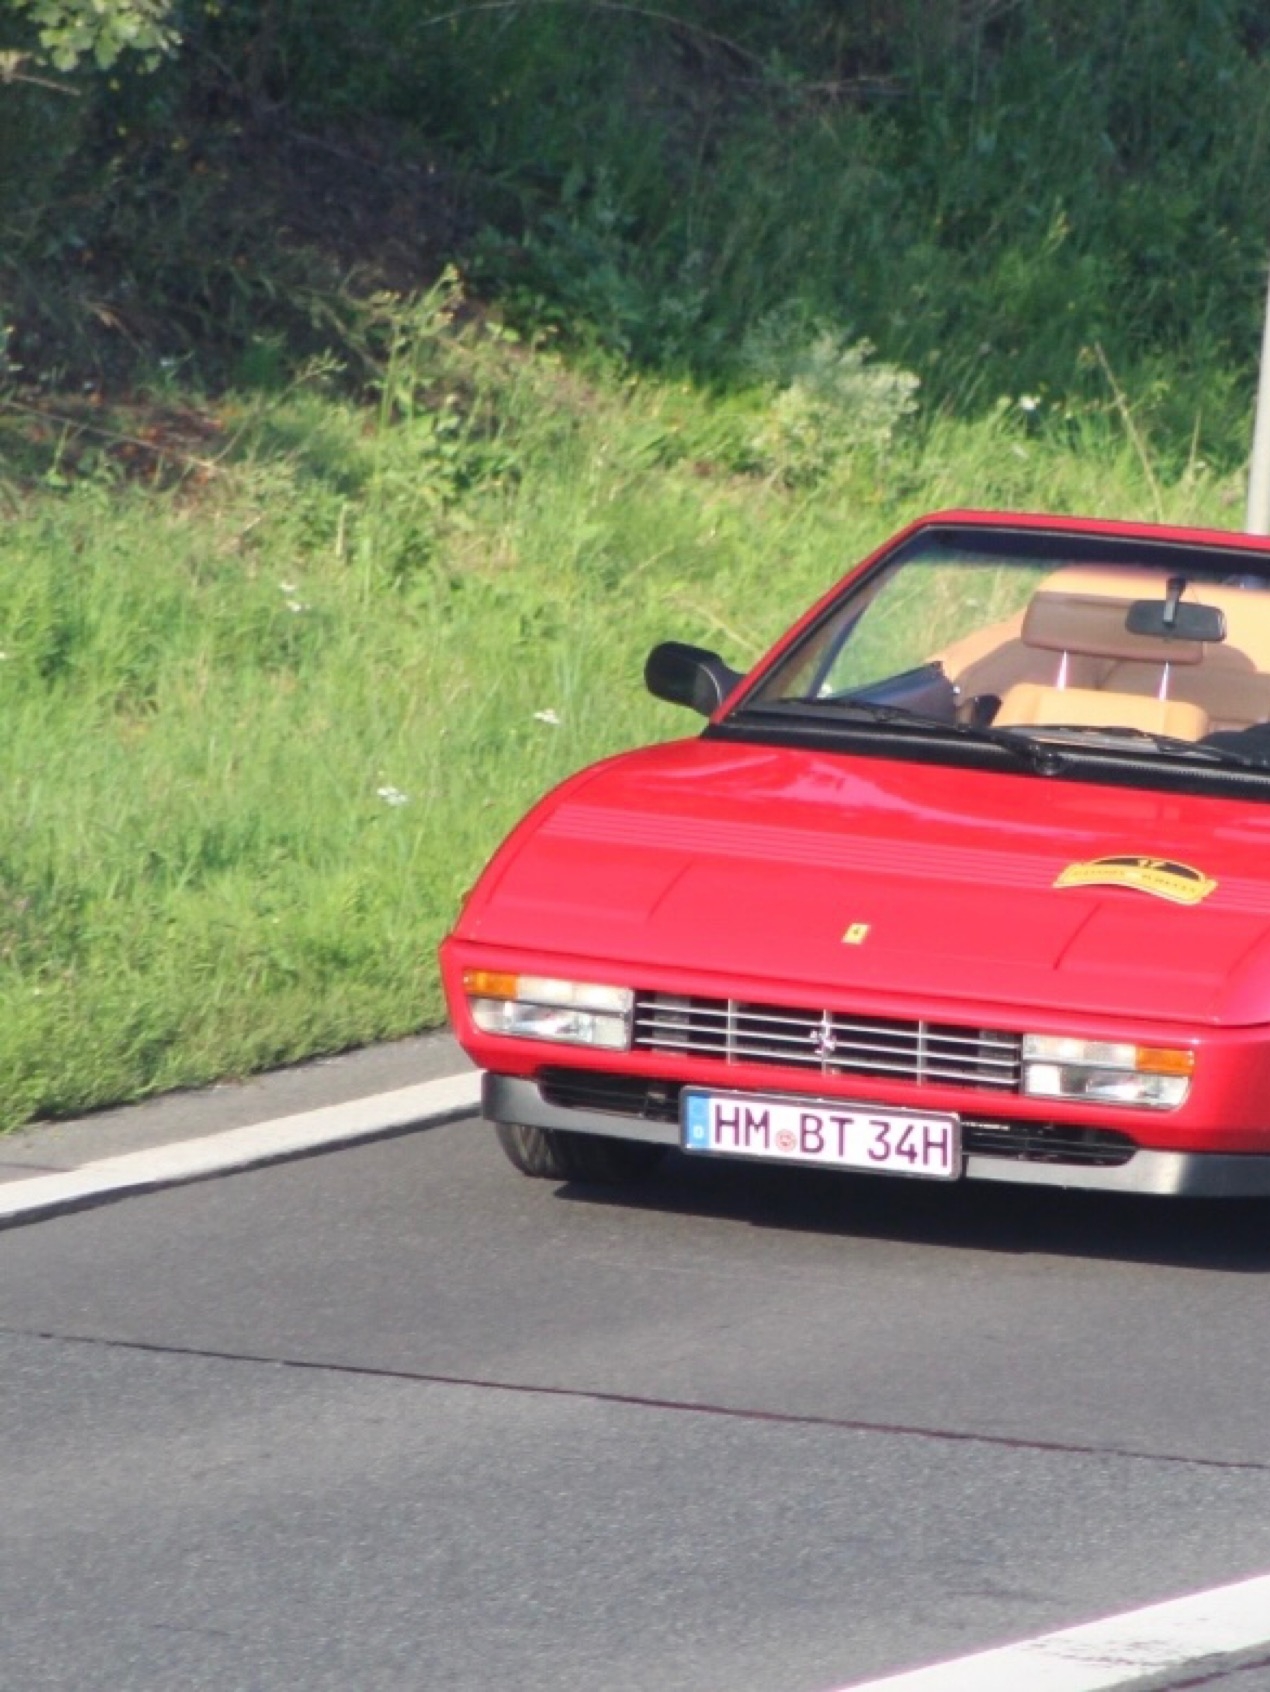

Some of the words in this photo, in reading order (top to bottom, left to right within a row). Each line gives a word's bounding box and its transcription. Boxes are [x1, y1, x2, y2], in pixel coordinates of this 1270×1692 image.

[714, 1103, 770, 1149] HM
[801, 1112, 854, 1157] BT
[868, 1119, 949, 1168] 34H
